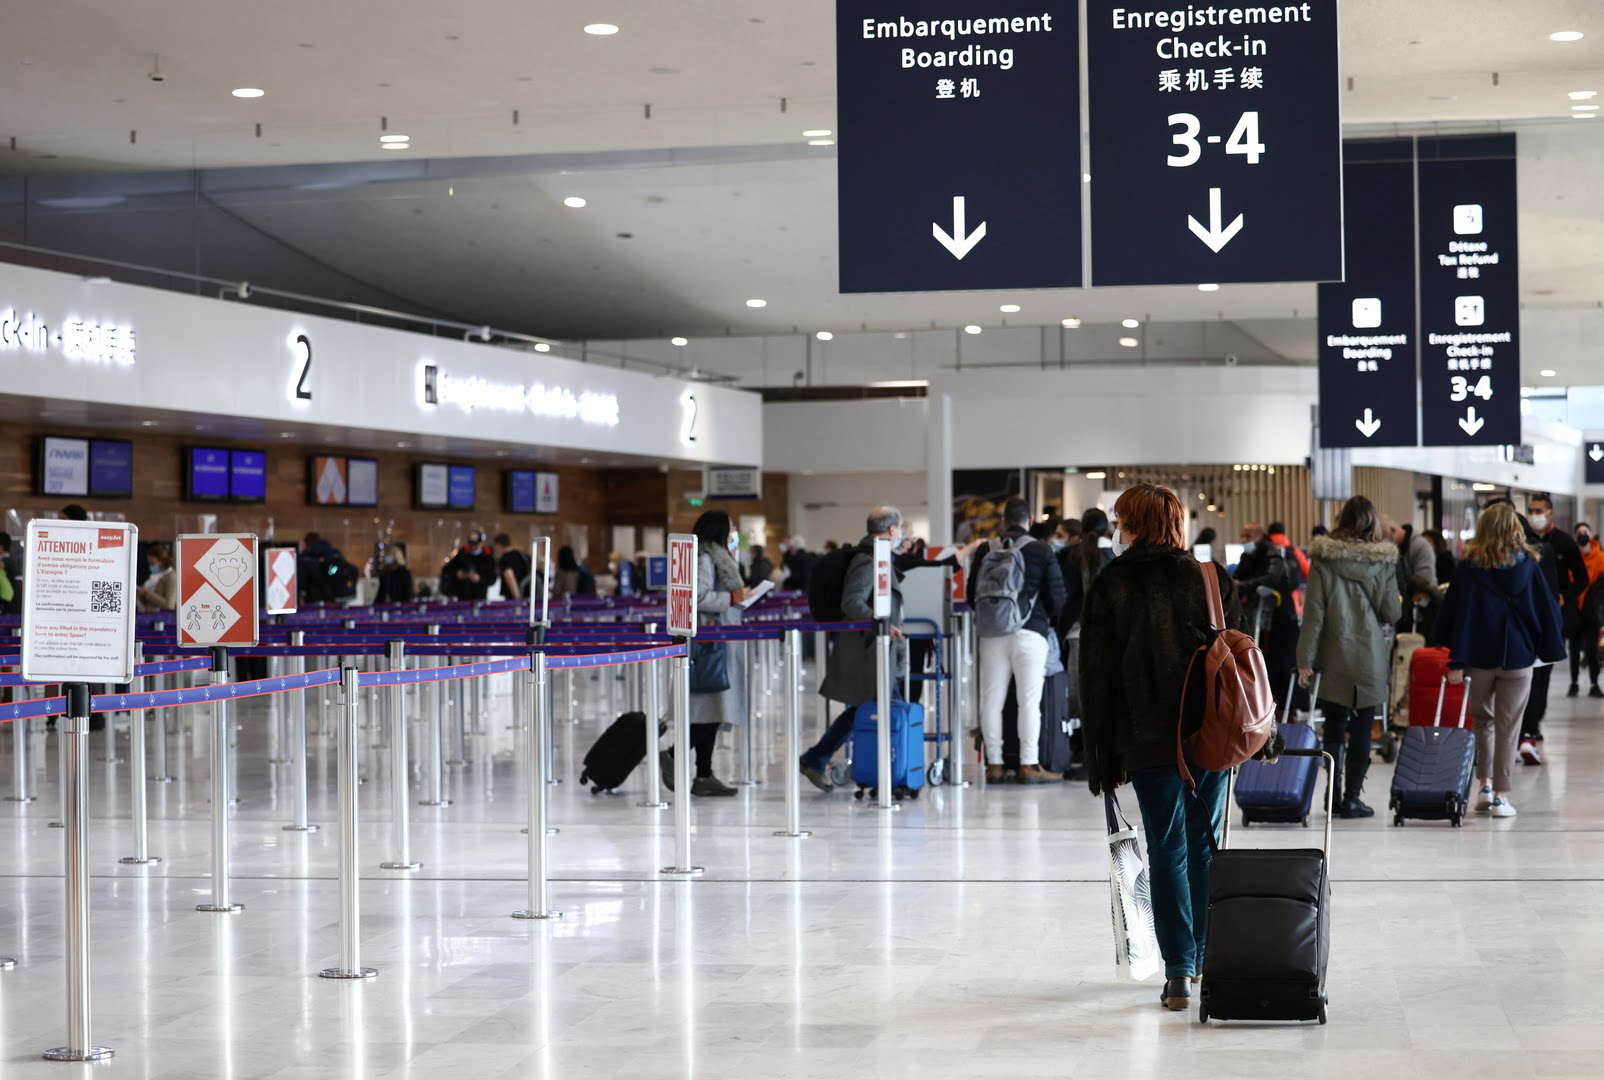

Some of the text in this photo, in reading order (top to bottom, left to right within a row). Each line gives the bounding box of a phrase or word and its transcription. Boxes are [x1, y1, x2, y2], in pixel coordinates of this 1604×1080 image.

[863, 13, 1052, 40] Embarquement
[1113, 3, 1311, 32] Enregistrement
[902, 45, 1013, 69] Boarding
[1157, 35, 1266, 59] Check-in
[936, 78, 980, 98] 登机
[1159, 67, 1263, 92] 乘机手续
[1167, 112, 1265, 167] 3-4
[1438, 251, 1498, 266] Tax Refund
[1327, 334, 1406, 347] Embarquement
[1429, 332, 1510, 346] Enregistrement
[1447, 345, 1493, 357] Check-in
[1343, 347, 1392, 360] Boarding
[295, 334, 312, 400] 2
[1451, 376, 1493, 401] 3-4
[38, 541, 92, 554] ATTENTION !
[671, 542, 693, 585] EXIT
[671, 589, 692, 629] SORTIE
